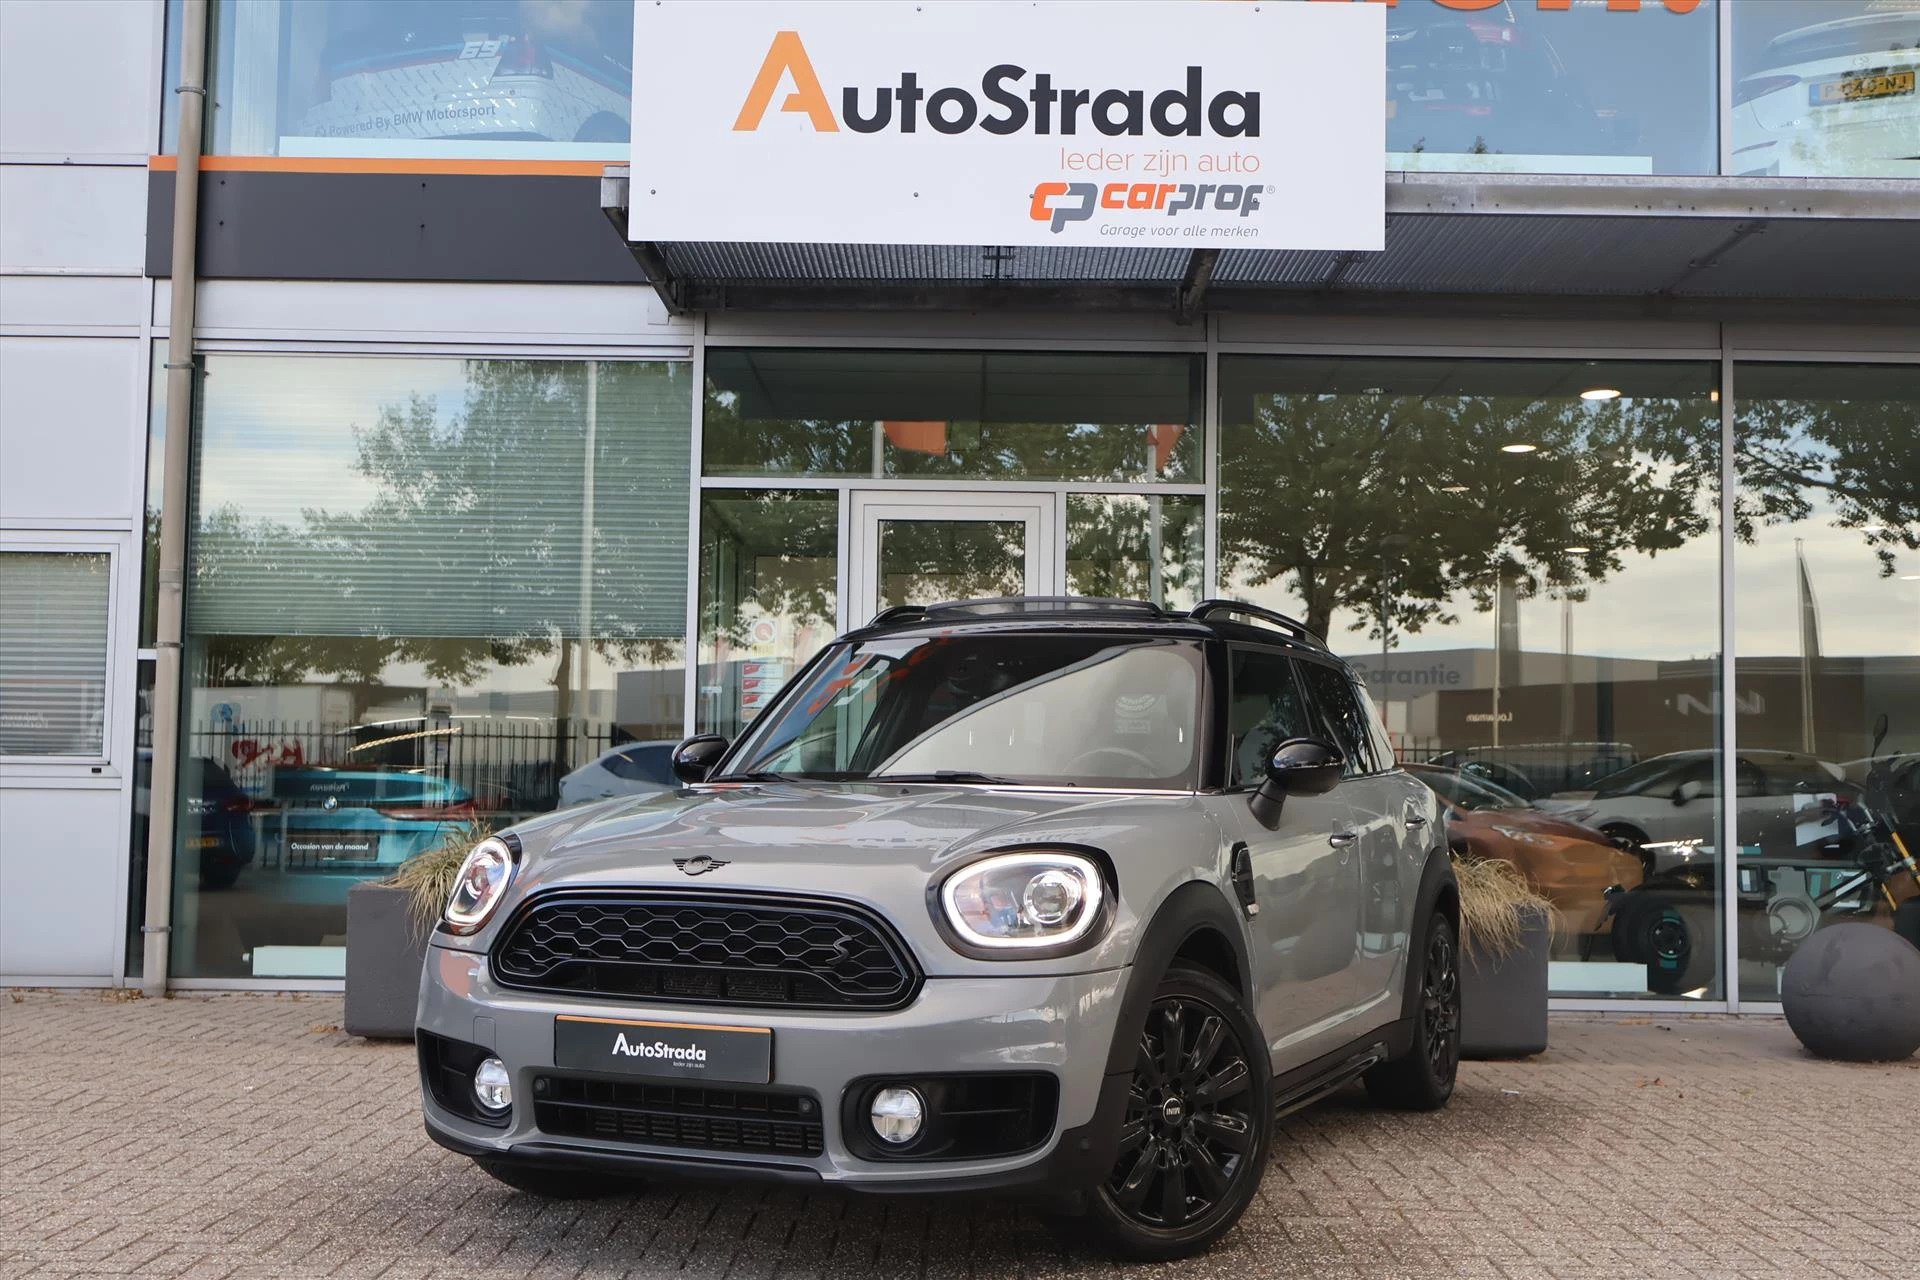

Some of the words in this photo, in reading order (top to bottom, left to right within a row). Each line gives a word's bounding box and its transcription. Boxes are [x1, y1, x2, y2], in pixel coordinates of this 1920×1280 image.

[459, 40, 502, 59] 69
[732, 30, 1260, 138] AutoStrada
[329, 119, 373, 135] Powered
[375, 116, 391, 130] By
[393, 111, 423, 126] BMW
[426, 105, 496, 121] Motorsport
[1060, 147, 1134, 171] Ieder
[1143, 149, 1188, 177] zijn
[1198, 151, 1260, 173] auto
[1099, 223, 1146, 239] Garage
[1150, 226, 1180, 237] voor
[1183, 225, 1207, 237] alle
[1210, 225, 1259, 237] merken
[291, 842, 321, 850] Occasion
[334, 842, 343, 850] de
[344, 842, 369, 850] maand
[612, 1032, 707, 1061] AutoStrada
